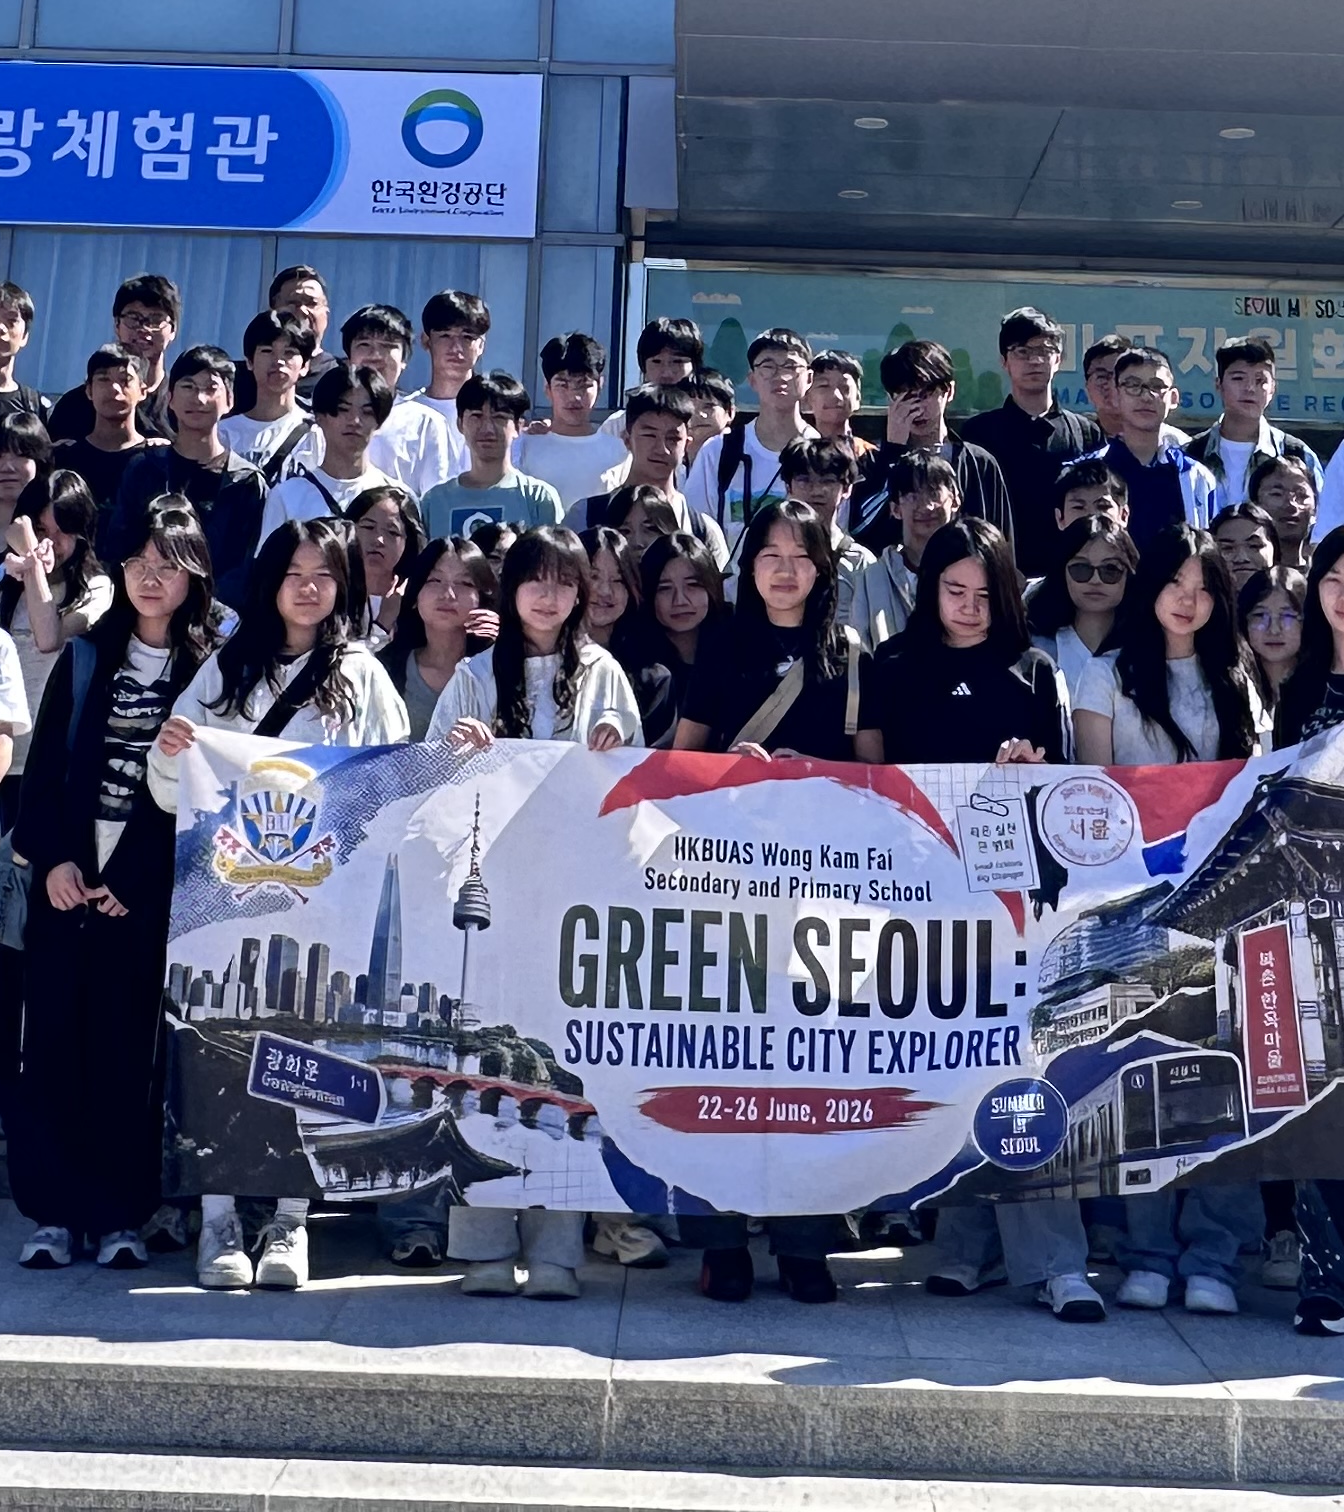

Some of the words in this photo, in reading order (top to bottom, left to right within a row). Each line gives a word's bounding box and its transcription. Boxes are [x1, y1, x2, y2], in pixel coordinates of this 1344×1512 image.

[1234, 296, 1282, 318] SEOUL
[674, 835, 754, 865] HKBUAS
[761, 841, 812, 872] Wong
[820, 844, 859, 870] Kam
[867, 847, 893, 871] Fai
[644, 866, 741, 900] Secondary
[748, 876, 780, 899] and
[788, 876, 862, 904] Primary
[869, 879, 933, 903] School
[558, 904, 769, 1015] GREEN
[791, 915, 1027, 1020] SEOUL:
[564, 1019, 775, 1071] SUSTAINABLE
[786, 1026, 856, 1074] CITY
[868, 1024, 1022, 1075] EXPLORER
[697, 1095, 758, 1122] 22-26
[765, 1096, 817, 1125] June,
[825, 1098, 874, 1124] 2026
